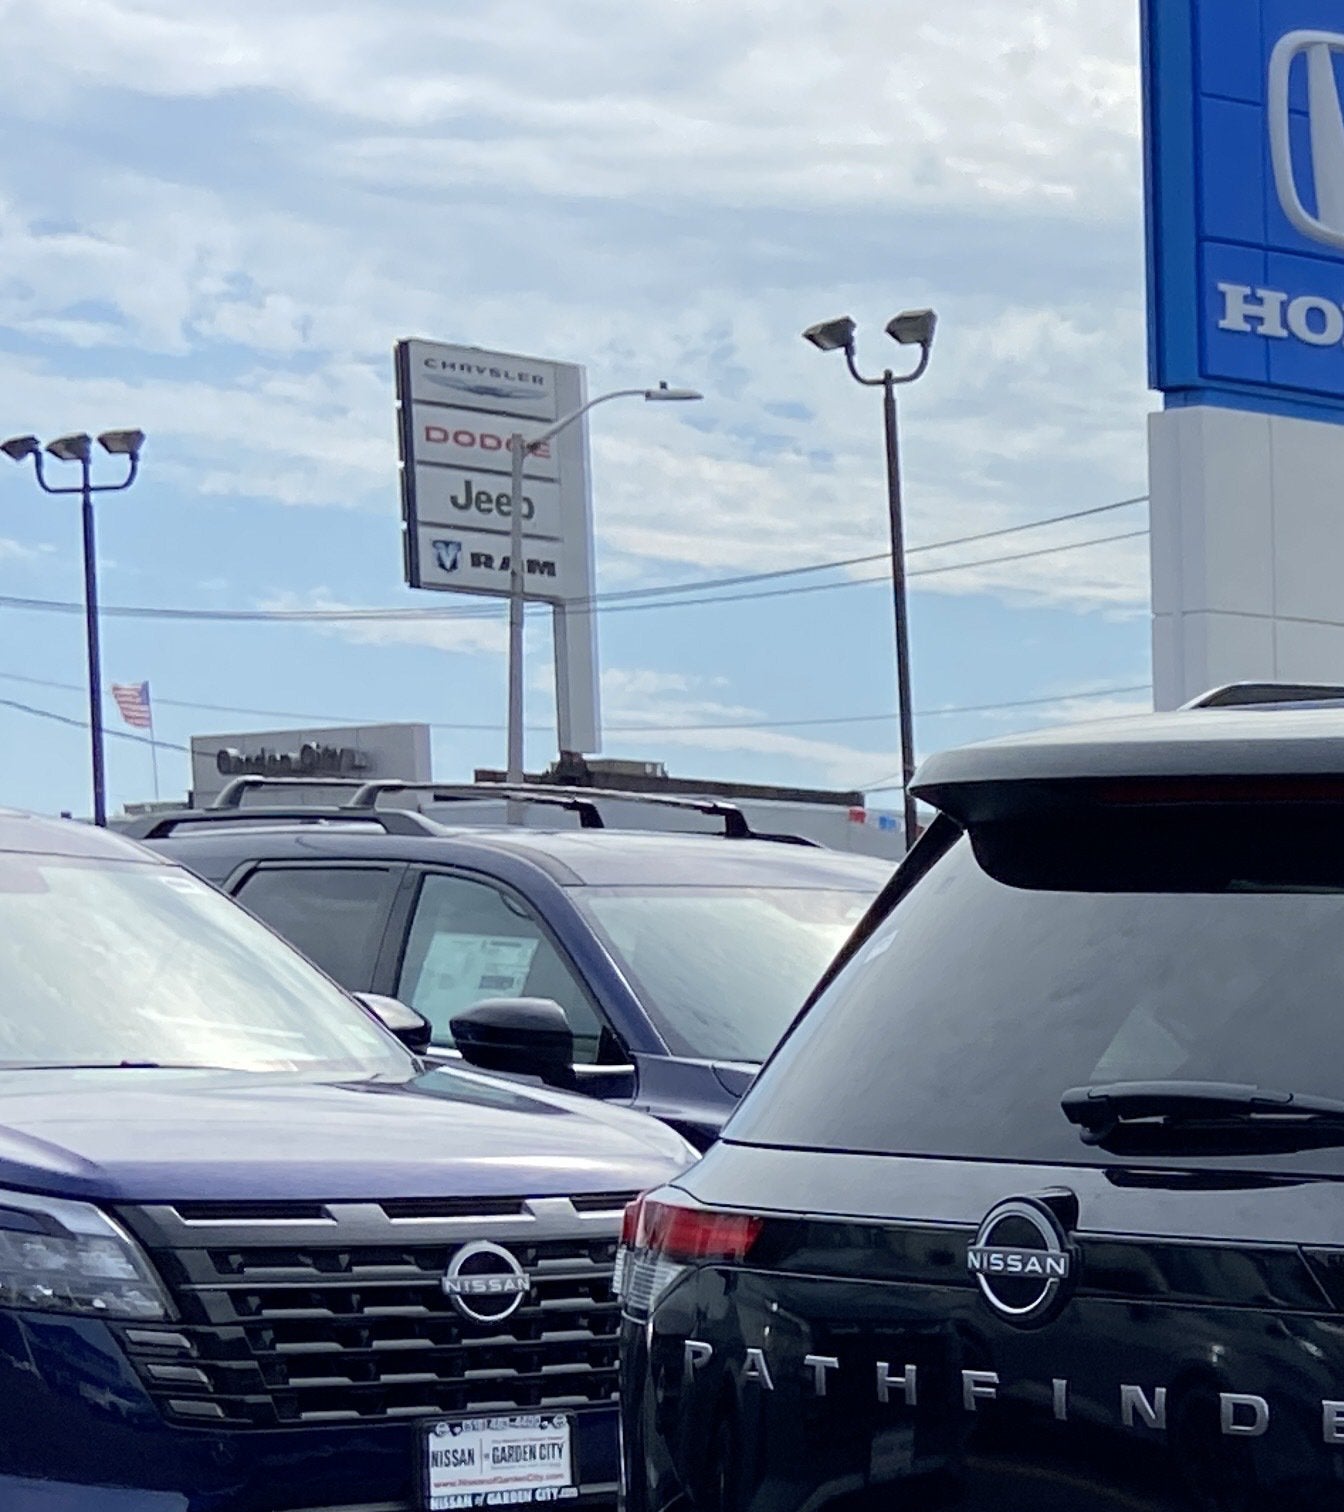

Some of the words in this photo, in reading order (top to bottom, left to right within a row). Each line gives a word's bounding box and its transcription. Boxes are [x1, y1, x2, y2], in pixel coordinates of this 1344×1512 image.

[424, 358, 545, 385] CHRYSLER
[967, 1251, 1065, 1275] NISSAN
[446, 1277, 530, 1293] NISSAN
[431, 1448, 475, 1468] NISSAN
[492, 1444, 537, 1464] GARDEN
[539, 1442, 564, 1461] CITY
